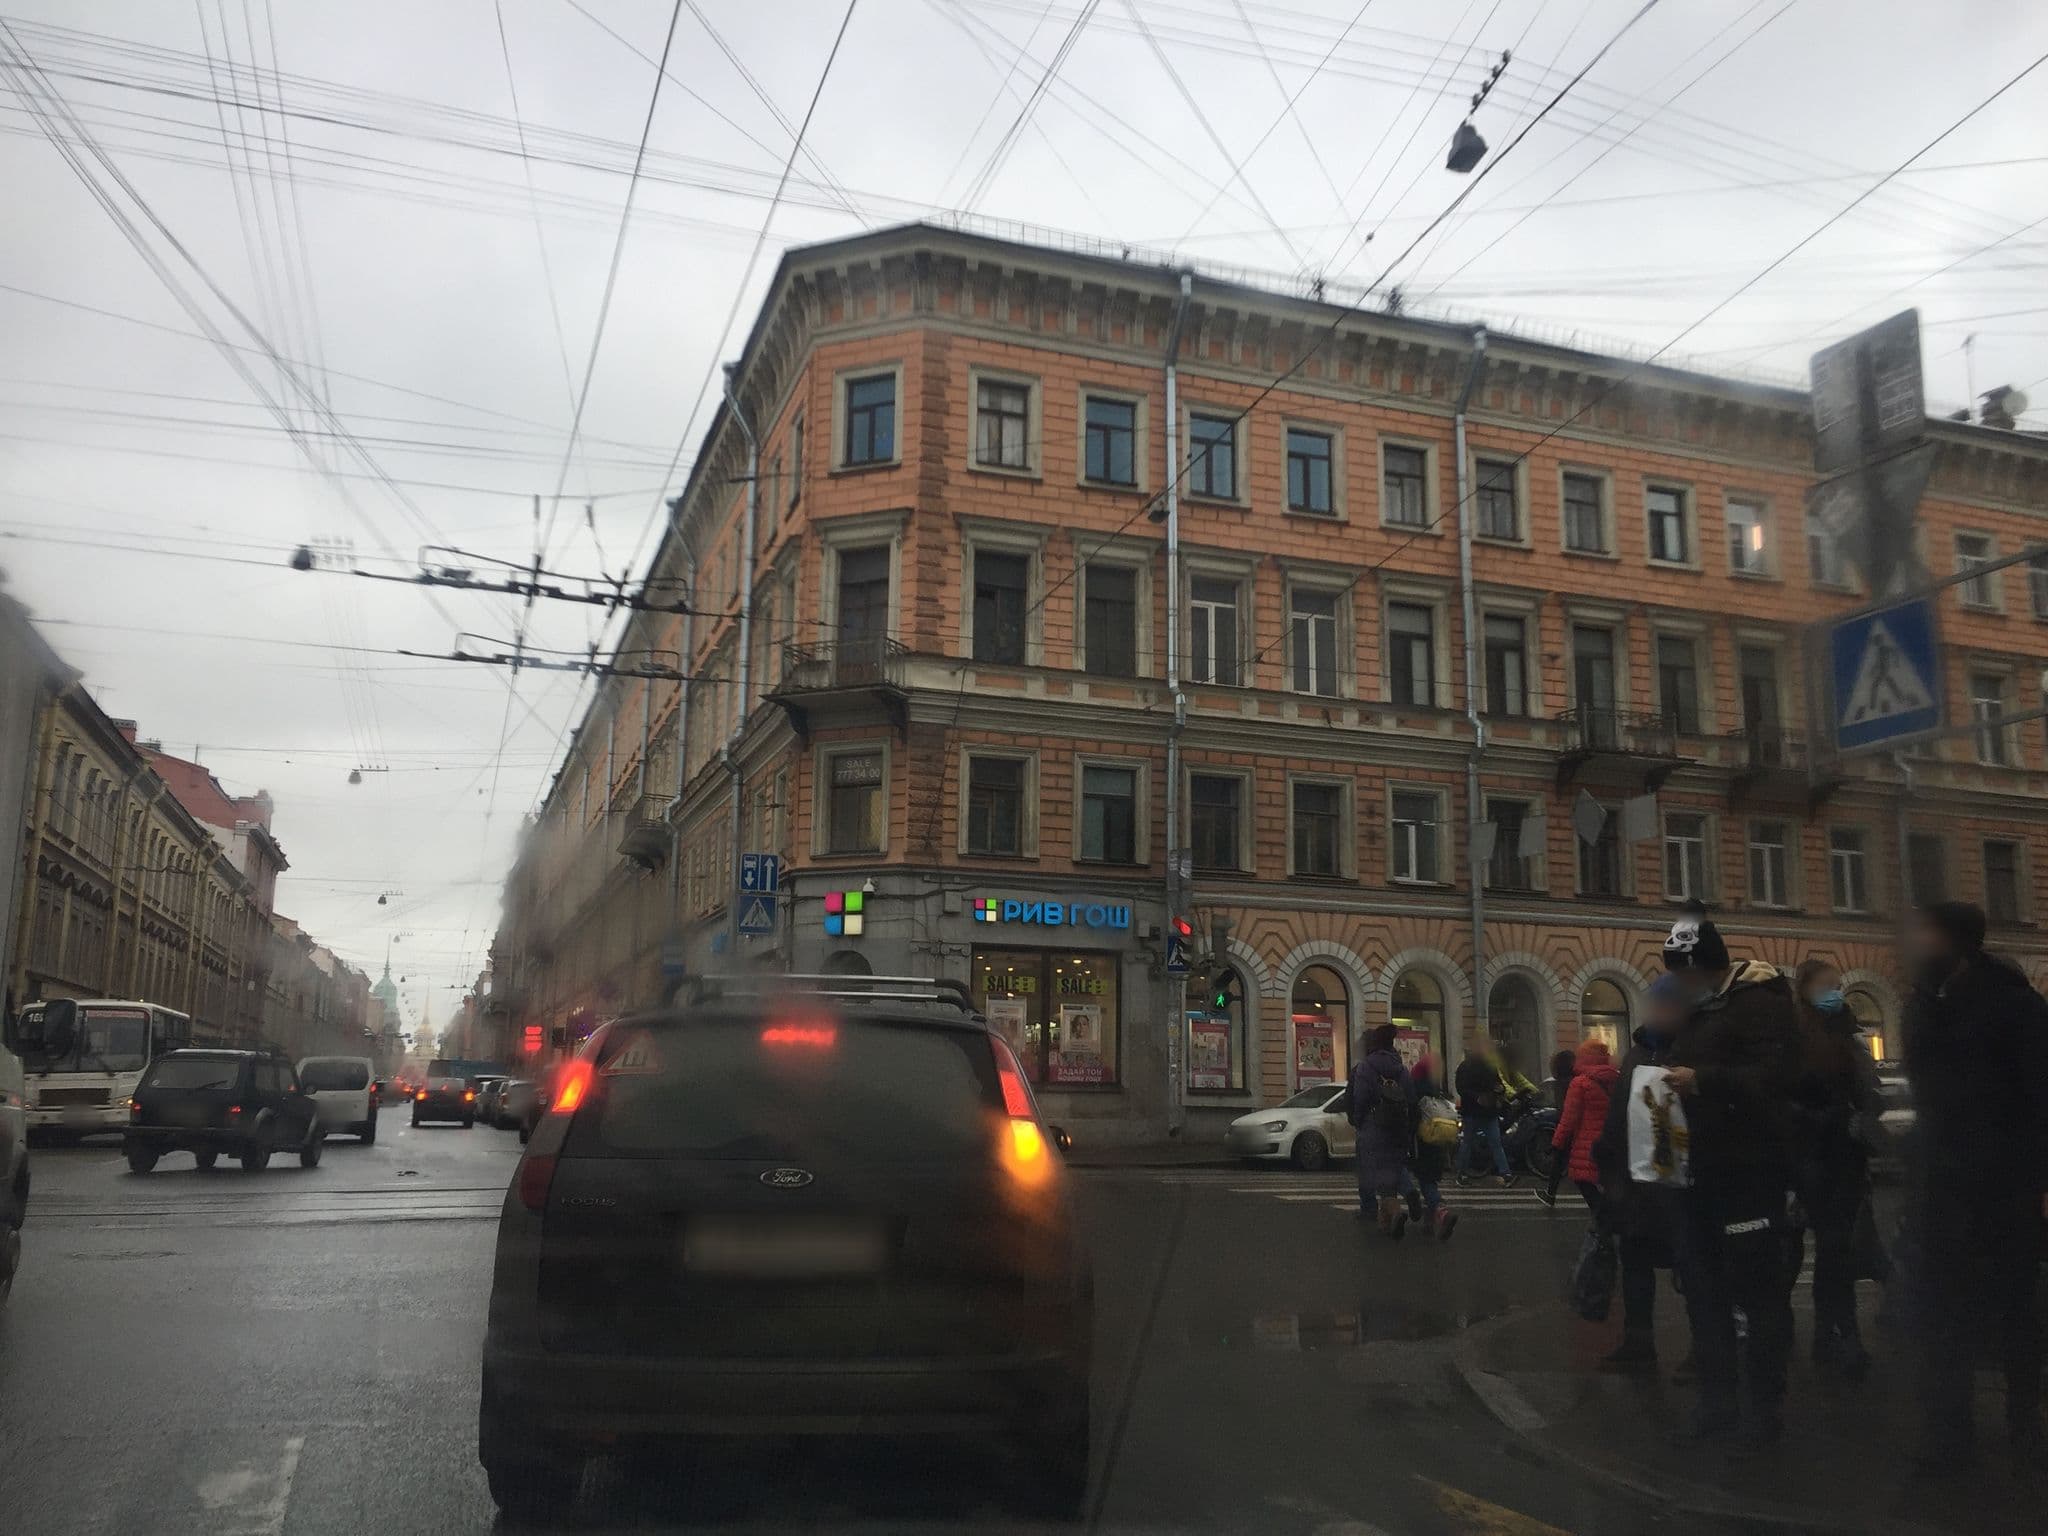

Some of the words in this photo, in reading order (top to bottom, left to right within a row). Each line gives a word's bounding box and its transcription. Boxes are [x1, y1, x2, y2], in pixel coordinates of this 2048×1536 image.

[1002, 899, 1064, 926] РИВ
[1069, 903, 1129, 929] ГОШ
[987, 975, 1019, 992] SALE
[1060, 978, 1093, 994] SALE
[772, 1170, 802, 1184] Ford
